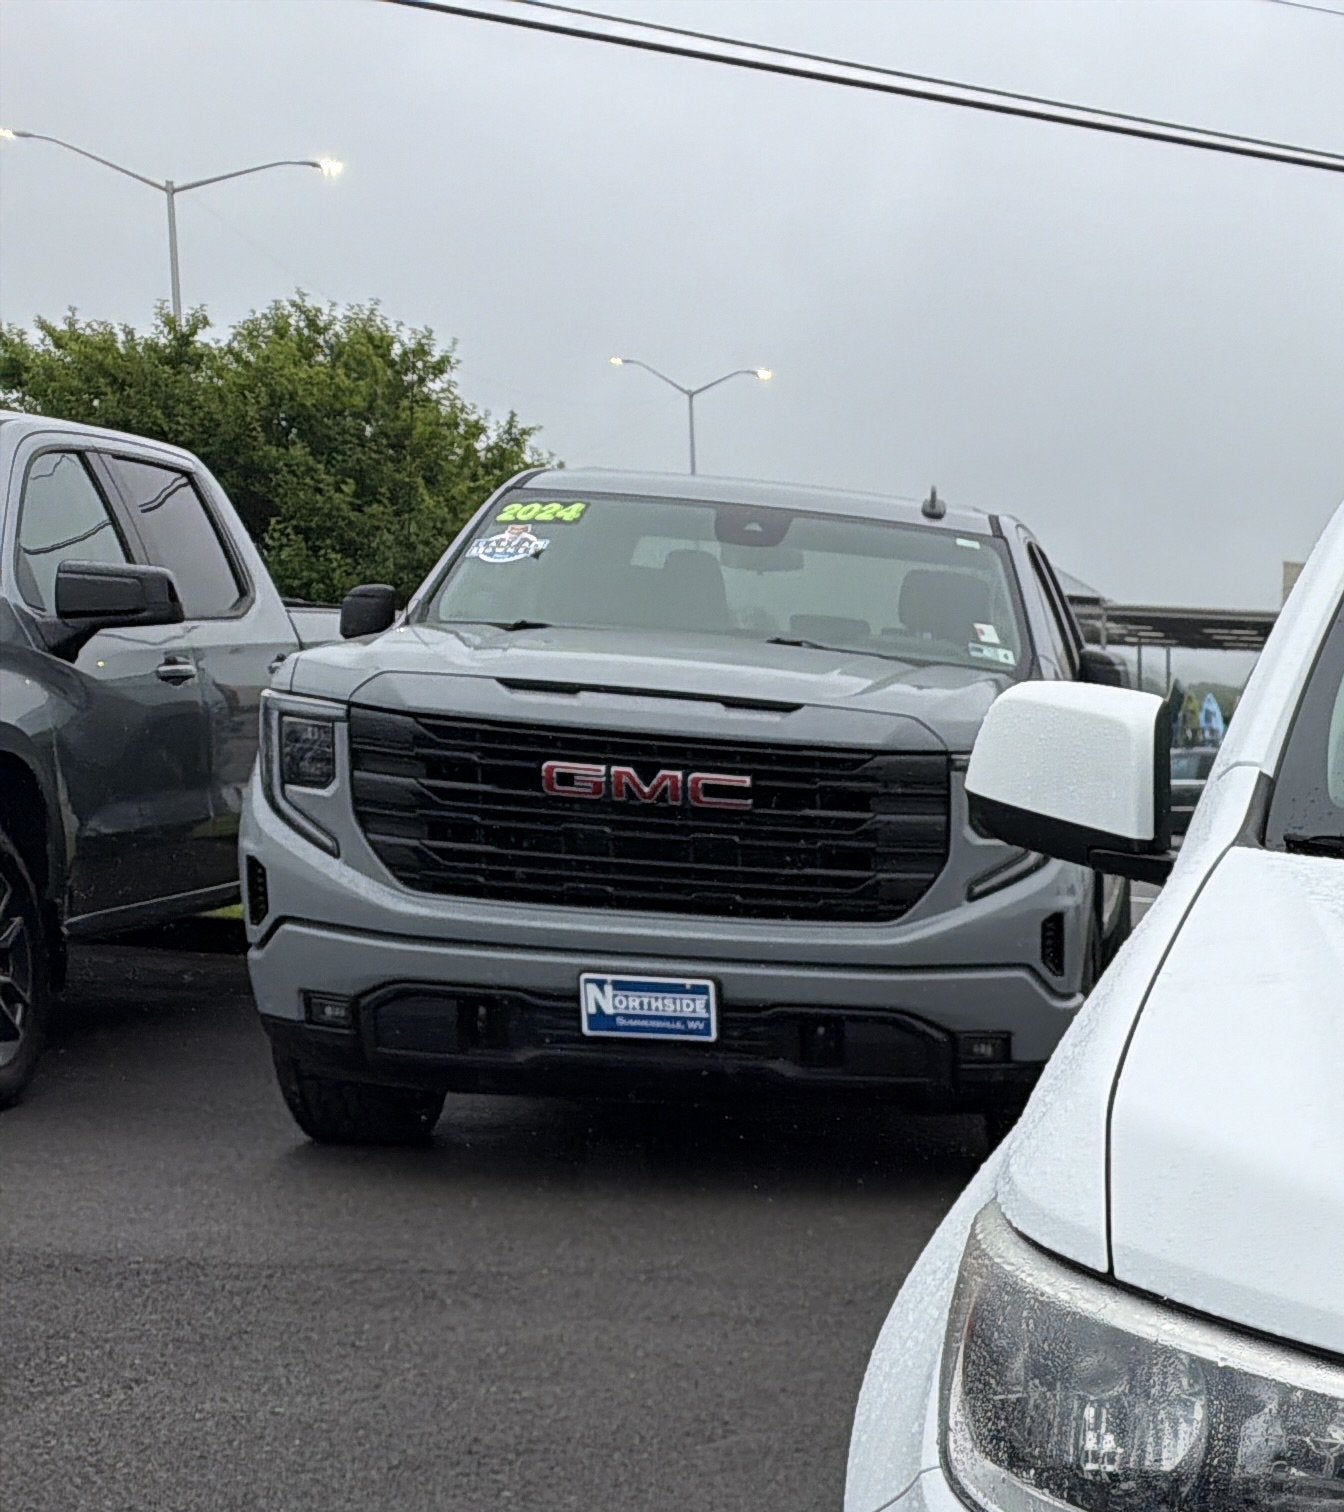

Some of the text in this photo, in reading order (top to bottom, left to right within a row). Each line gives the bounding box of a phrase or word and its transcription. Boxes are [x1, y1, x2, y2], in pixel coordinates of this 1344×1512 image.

[495, 502, 587, 522] 2024
[541, 760, 753, 810] GMC
[586, 982, 707, 1015] NORTHSIDE
